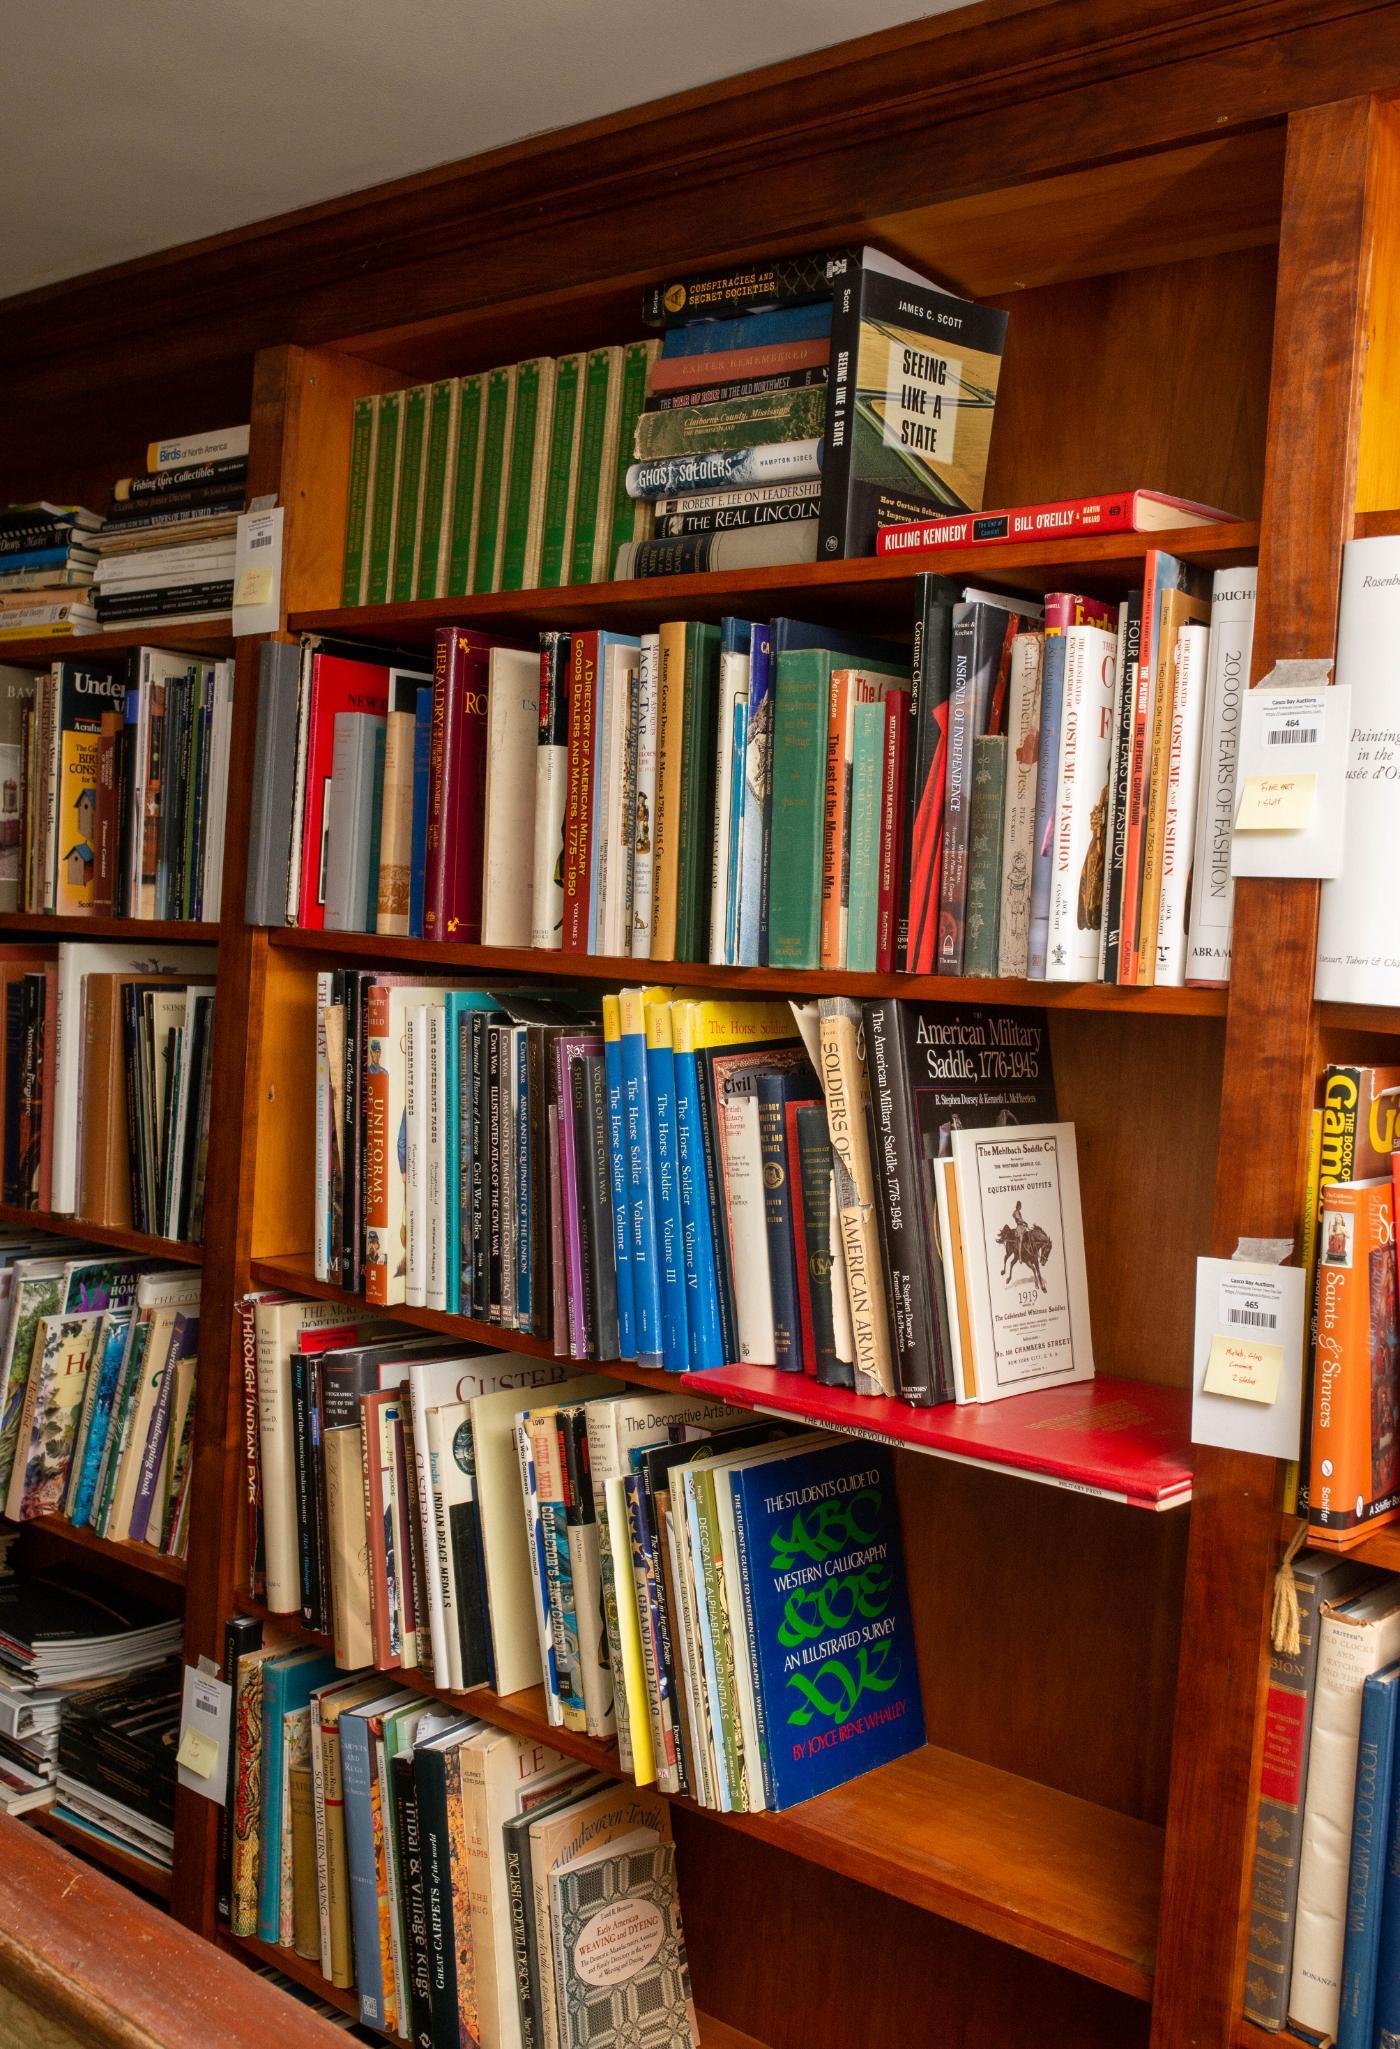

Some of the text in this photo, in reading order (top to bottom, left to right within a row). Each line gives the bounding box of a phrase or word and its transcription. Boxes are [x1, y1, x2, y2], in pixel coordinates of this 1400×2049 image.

[689, 272, 774, 294] CONSPIRACIES AND
[689, 281, 776, 305] SECRET SOCIETIES
[842, 289, 851, 313] Scott
[898, 301, 963, 329] JAMES C. SCOTT
[903, 349, 947, 385] SEEING
[901, 384, 942, 419] LIKE A
[159, 441, 228, 463] Birds of North America
[901, 420, 937, 453] STATE
[133, 466, 215, 492] Fishing Lure Collectibles
[638, 454, 813, 488] GHOST SOLDIERS HAMPTON SIDES
[682, 480, 822, 510] ROBERT E. LEE ON LEADERSHIP
[687, 500, 821, 531] THE REAL LINCOLN
[885, 510, 1076, 551] KILLING KENNEDY BILL O'REILLY
[574, 639, 584, 681] GOODS
[434, 643, 446, 728] HERALDRY
[637, 645, 651, 736] JACK TAR
[573, 683, 582, 739] DEALERS
[950, 656, 967, 812] INSIGNIA OF INDEPENDENCE
[1285, 720, 1300, 728] 464
[571, 747, 580, 766] AND
[1063, 712, 1077, 784] COSTUME
[1131, 665, 1148, 826] THE PATRIOT THE OFFICIAL COMPANION
[1350, 728, 1400, 746] Painting
[1357, 747, 1394, 761] in the
[578, 660, 593, 876] A DIRECTORY OF AMERICAN MILITARY
[823, 678, 839, 900] Peterson The Last of the Mountain Men
[1210, 652, 1241, 899] 20,000 YEARS OF FASHION
[569, 767, 579, 821] MAKERS,
[1059, 803, 1072, 873] FASHION
[916, 1015, 1042, 1051] American Military
[927, 1049, 1038, 1083] Saddle, 1776-1945
[823, 1042, 851, 1162] SOLDIERS OF
[372, 1099, 384, 1204] UNIFORMS
[627, 1078, 647, 1262] The Horse Soldier Volume II
[978, 1141, 1057, 1157] The Mehlbach Saddle Co.
[1341, 1112, 1354, 1183] THE BOOK OF
[987, 1180, 1053, 1194] EQUESTRIAN OUTFITS
[842, 1214, 876, 1376] AMERICAN ARMY
[1018, 1289, 1039, 1305] 1919
[1244, 1300, 1259, 1310] 465
[1319, 1271, 1344, 1428] Saints & Sinners
[243, 1311, 257, 1459] THROUGH INDIAN
[140, 1340, 179, 1497] Northeastern Landscaping Book
[764, 1468, 880, 1514] THE STUDENT'S GUIDE TO
[1321, 1486, 1331, 1523] Schiffer
[433, 1492, 452, 1608] INDIAN PEACE MEDALS
[774, 1544, 888, 1593] WESTERN CALLIGRAPHY
[540, 1506, 565, 1664] COLLECTOR'S ENCYCLOPEDIA
[698, 1517, 730, 1720] DECORATIVE ALPHABETS AND INITIALS
[636, 1581, 660, 1716] A GRAND OLD FLAG
[784, 1616, 896, 1672] AN ILLUSTRATED SURVEY
[793, 1699, 907, 1761] BY JOYCE IRENE WHALLEY
[315, 1770, 328, 1917] SOUTHWESTERN WEAVING
[431, 1888, 445, 1990] GREAT CARPETS
[578, 1916, 659, 1957] WEAVING and DYEING
[1302, 1969, 1337, 1987] BONANZA
